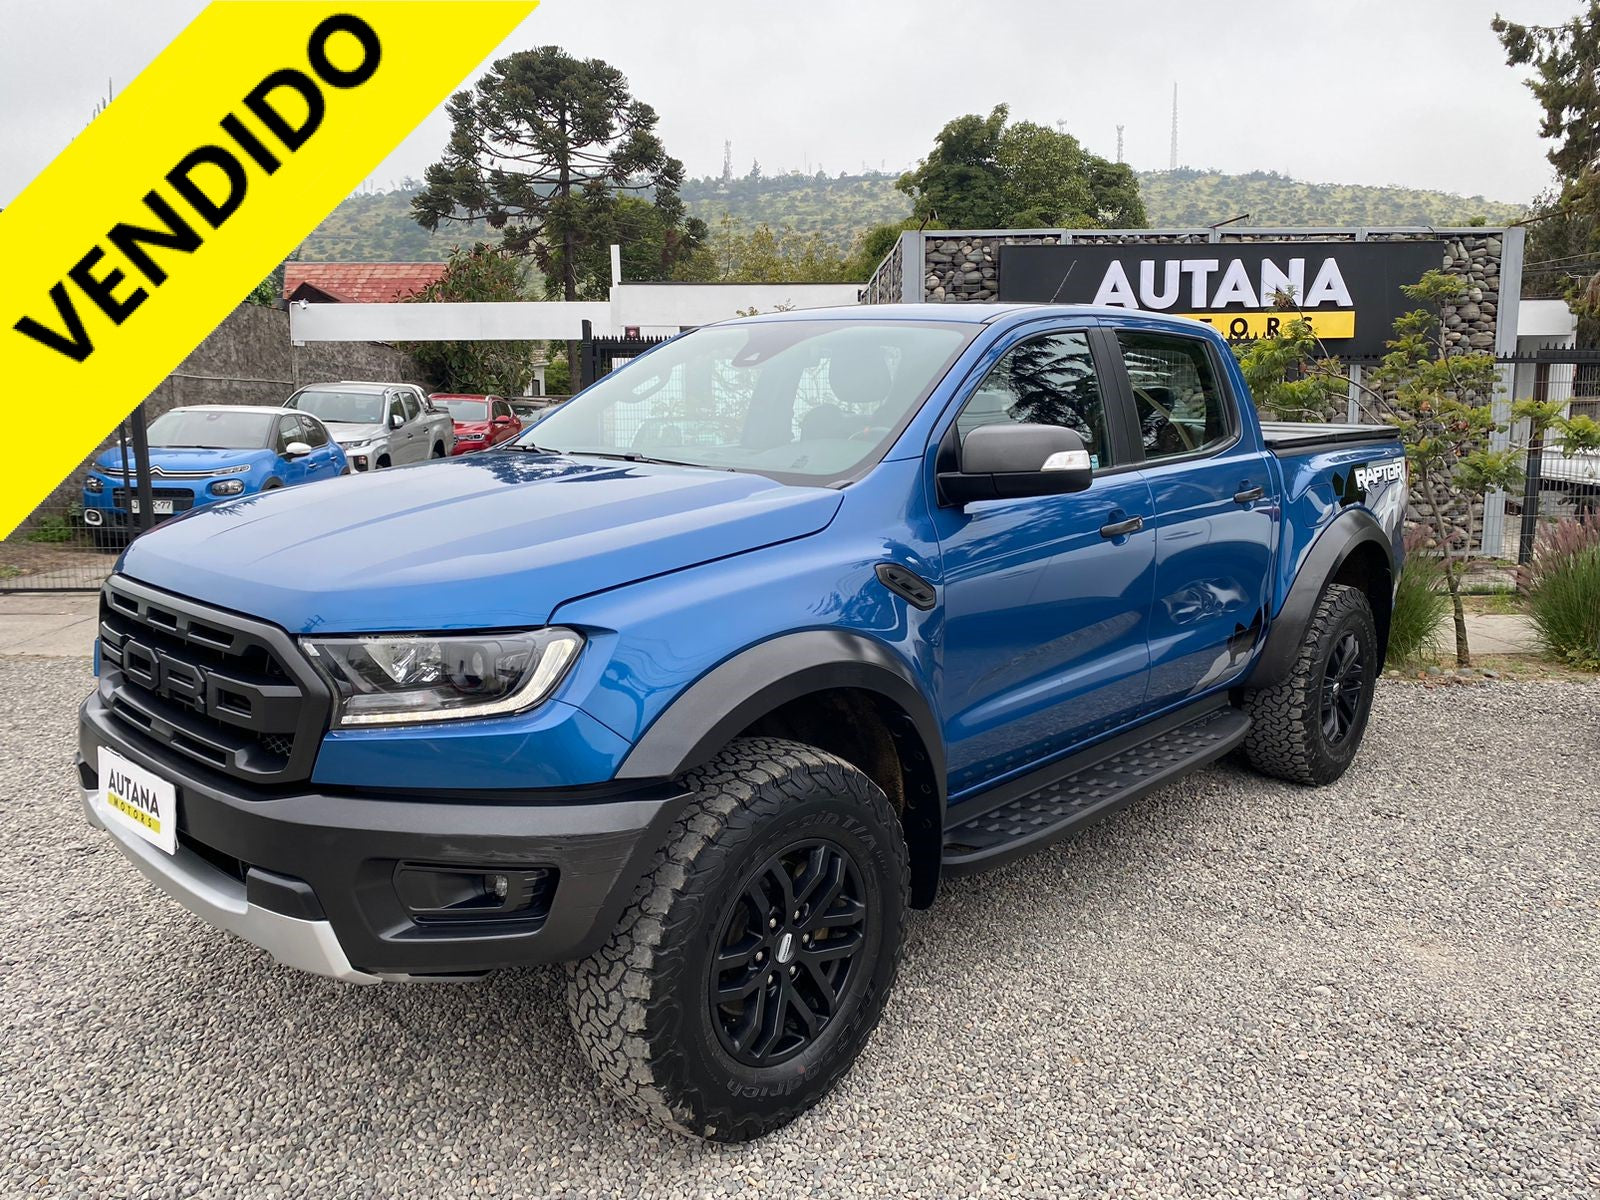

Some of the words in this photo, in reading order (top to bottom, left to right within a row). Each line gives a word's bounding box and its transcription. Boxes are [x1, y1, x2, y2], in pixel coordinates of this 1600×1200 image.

[1092, 257, 1354, 310] AUTANA
[1353, 462, 1404, 493] RAPTOR
[108, 768, 160, 818] AUTANA
[113, 797, 152, 828] MOTORS
